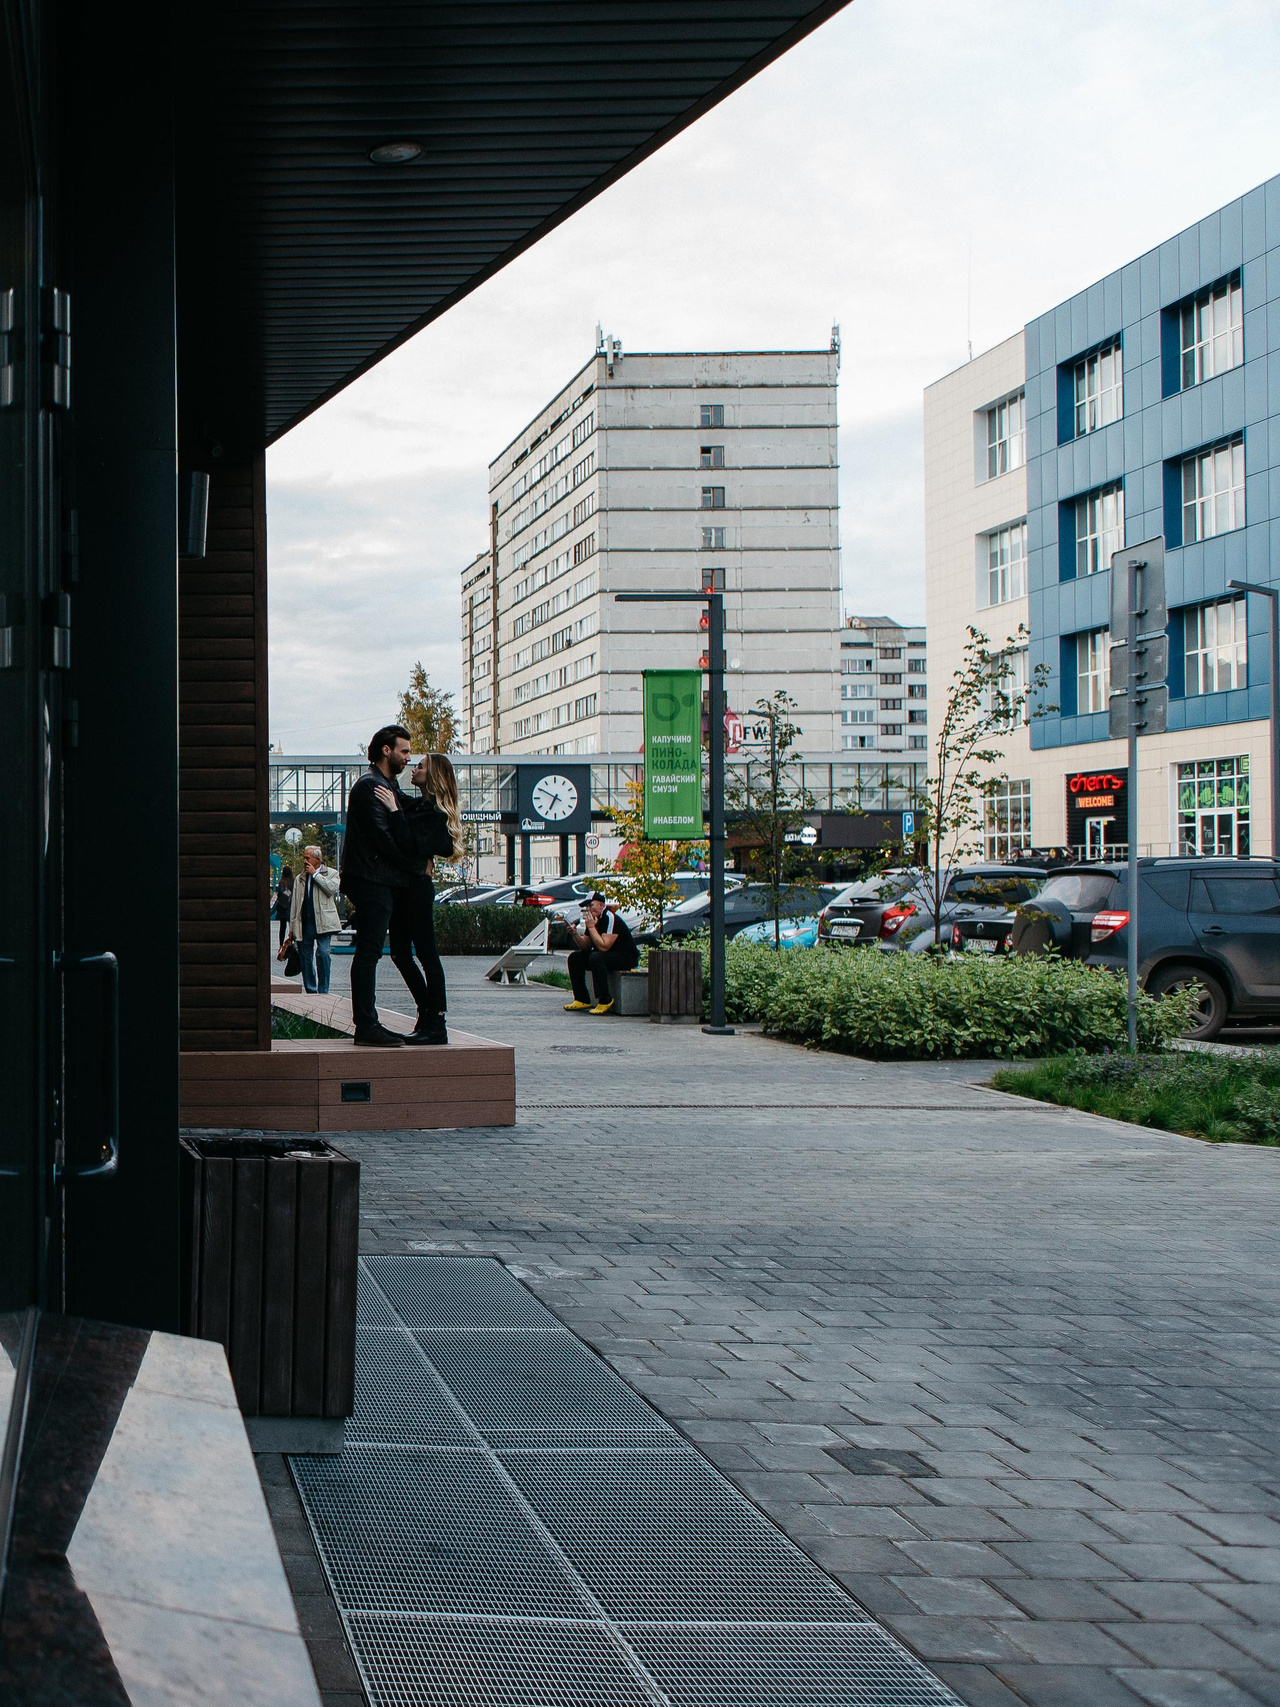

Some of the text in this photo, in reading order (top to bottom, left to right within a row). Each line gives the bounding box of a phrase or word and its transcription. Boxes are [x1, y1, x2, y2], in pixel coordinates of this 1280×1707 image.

[651, 735, 692, 744] КАПУЧИНО
[651, 747, 687, 758] ПИНО-
[651, 759, 697, 771] КОЛАДА
[652, 773, 696, 783] ГАВАЙСКИЙ
[652, 785, 678, 793] СМУЗИ
[1077, 795, 1113, 808] WELCOME
[653, 816, 694, 825] #НАБЕЛОМ
